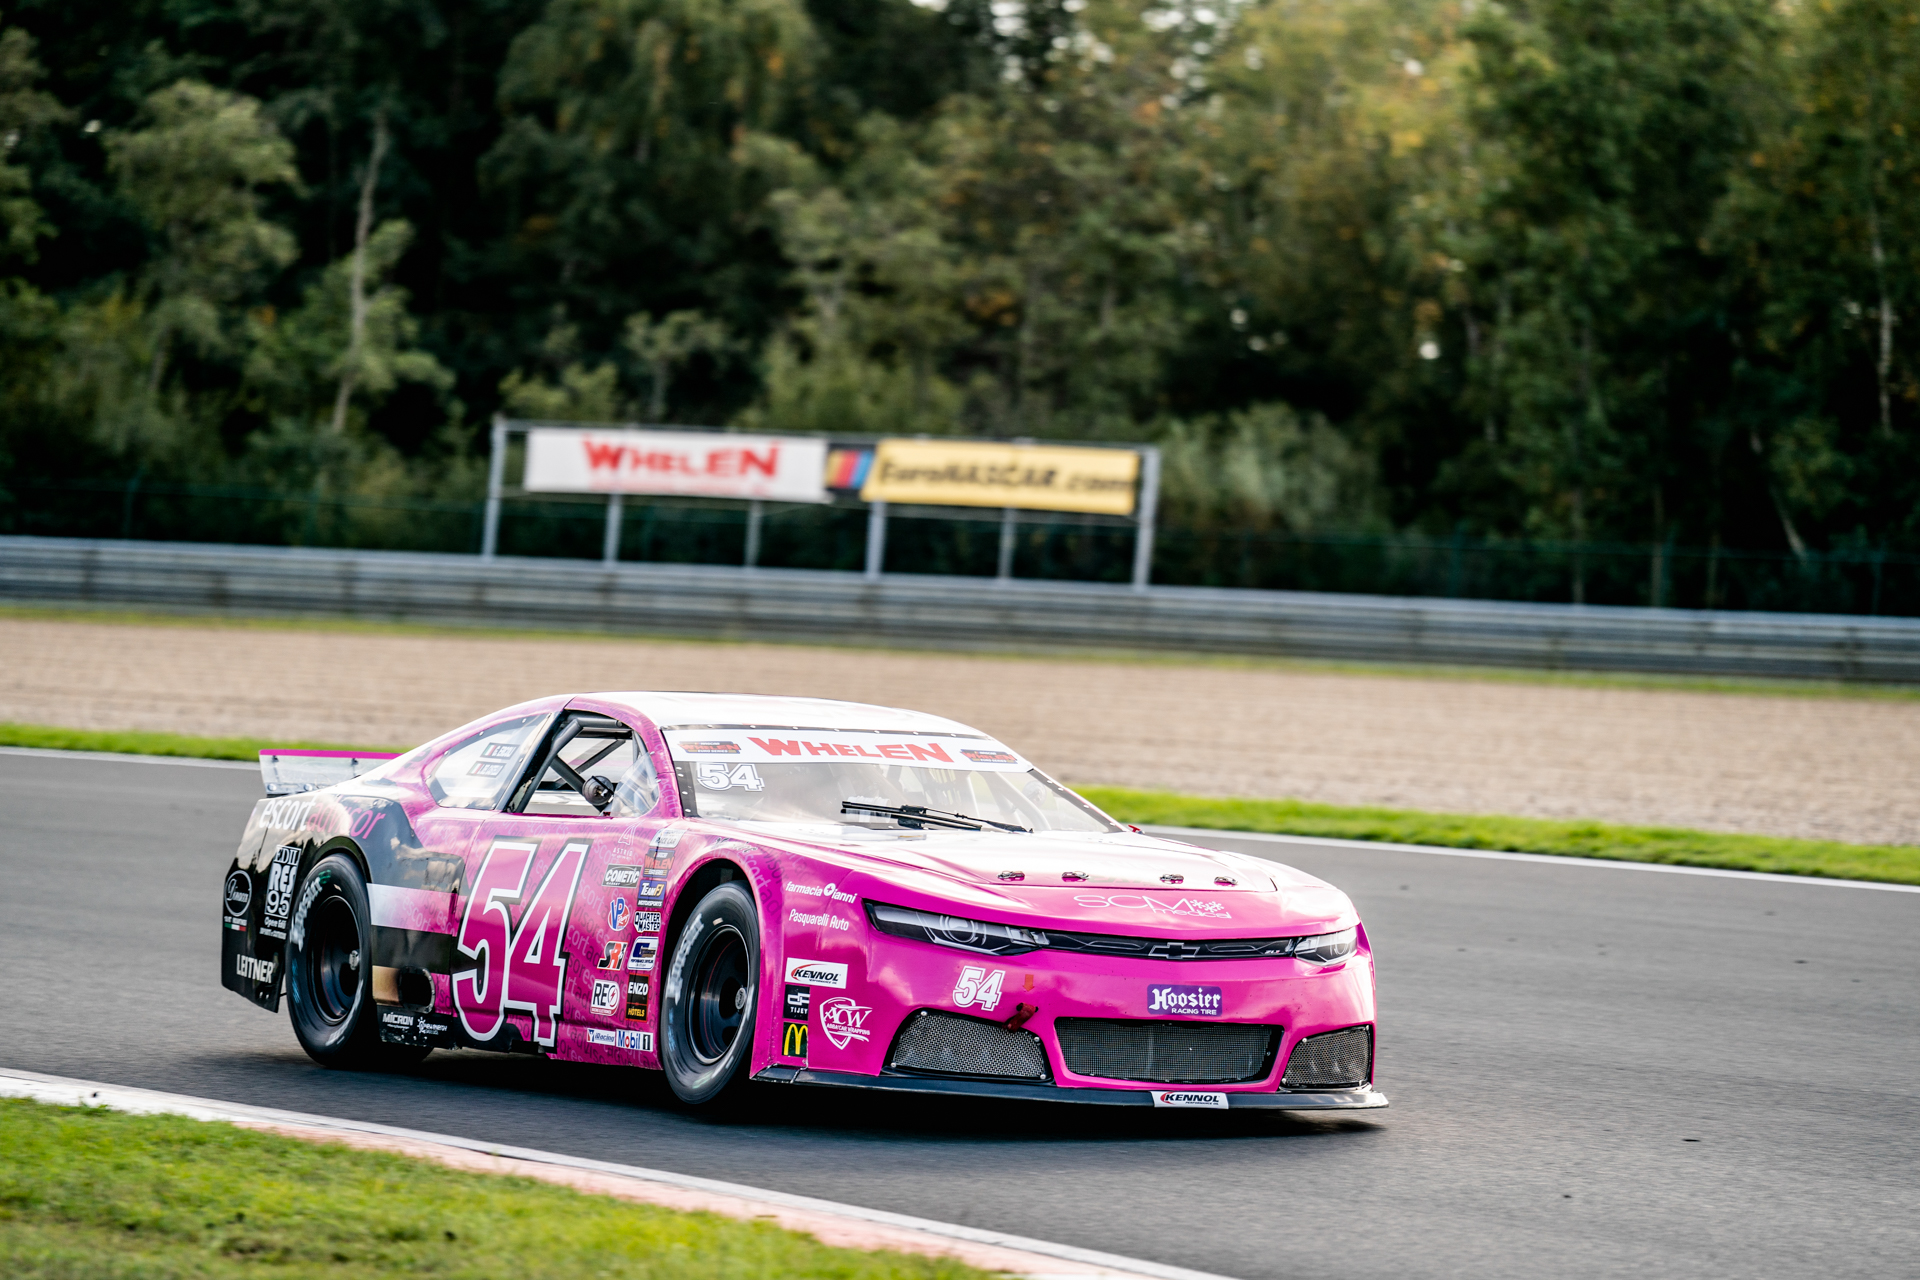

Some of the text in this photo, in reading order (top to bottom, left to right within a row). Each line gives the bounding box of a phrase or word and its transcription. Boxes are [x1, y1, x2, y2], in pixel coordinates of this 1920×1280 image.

[582, 436, 781, 477] WHELEN
[747, 736, 955, 763] WHELEN
[696, 763, 765, 792] 54
[273, 847, 299, 866] EDIL
[268, 863, 298, 894] RES
[604, 868, 640, 883] COMETIC
[785, 881, 823, 897] farmacia
[266, 890, 291, 916] 95
[1073, 894, 1195, 912] SCM
[1153, 907, 1233, 919] medical
[634, 912, 661, 925] QUARTER
[637, 921, 661, 932] MASTER
[788, 908, 850, 931] Pasquarelli Auto
[452, 838, 592, 1048] 54
[236, 953, 275, 983] LEITNER
[794, 968, 840, 982] KENNOL
[627, 981, 649, 996] ENZO
[952, 965, 1006, 1012] 54
[1149, 987, 1221, 1010] Hoosier
[824, 1006, 873, 1028] ACW
[1171, 1007, 1199, 1015] RACING
[594, 1032, 615, 1043] iRacing
[618, 1029, 651, 1050] Mobil 1
[1164, 1094, 1220, 1103] KENNOL
